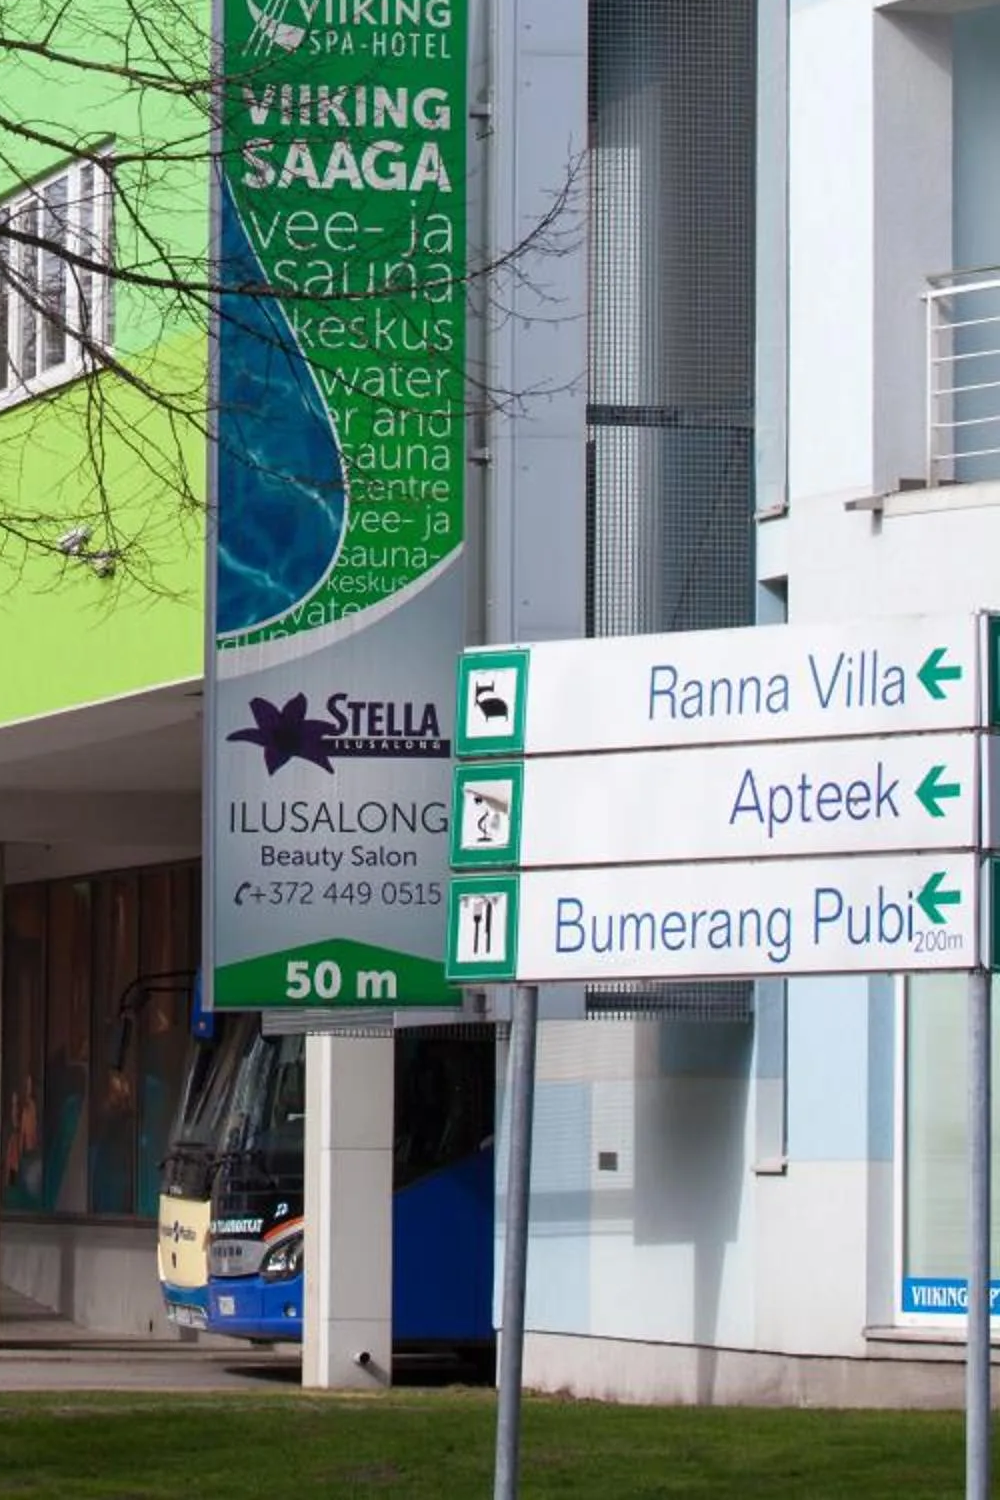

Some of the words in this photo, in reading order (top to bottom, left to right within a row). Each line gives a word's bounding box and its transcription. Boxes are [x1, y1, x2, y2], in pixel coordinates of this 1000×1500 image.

[310, 30, 451, 58] SPA-HOTEL
[242, 83, 451, 130] VIIKING
[241, 137, 452, 192] SAAGA
[250, 210, 384, 251] vee-
[402, 199, 453, 257] ja
[273, 259, 453, 303] sauna
[293, 308, 454, 351] keskus
[320, 361, 450, 397] water
[373, 399, 451, 438] and
[340, 443, 451, 471] sauna
[350, 474, 450, 501] centre
[421, 503, 450, 541] ja
[336, 544, 441, 569] sauna-
[648, 665, 789, 720] Ranna
[808, 649, 905, 710] Villa
[335, 739, 441, 750] ILUSALONG
[229, 801, 448, 834] ILUSALONG
[729, 762, 901, 838] Apteek
[261, 846, 343, 872] Beauty
[351, 846, 417, 868] Salon
[251, 881, 314, 905] +372
[322, 882, 372, 905] 449
[381, 882, 442, 905] 0515
[555, 897, 792, 964] Bumerang
[813, 886, 914, 944] Pubi
[914, 931, 963, 953] 200m
[286, 961, 342, 999] 50
[356, 969, 397, 999] m
[912, 1286, 968, 1307] VIIKING
